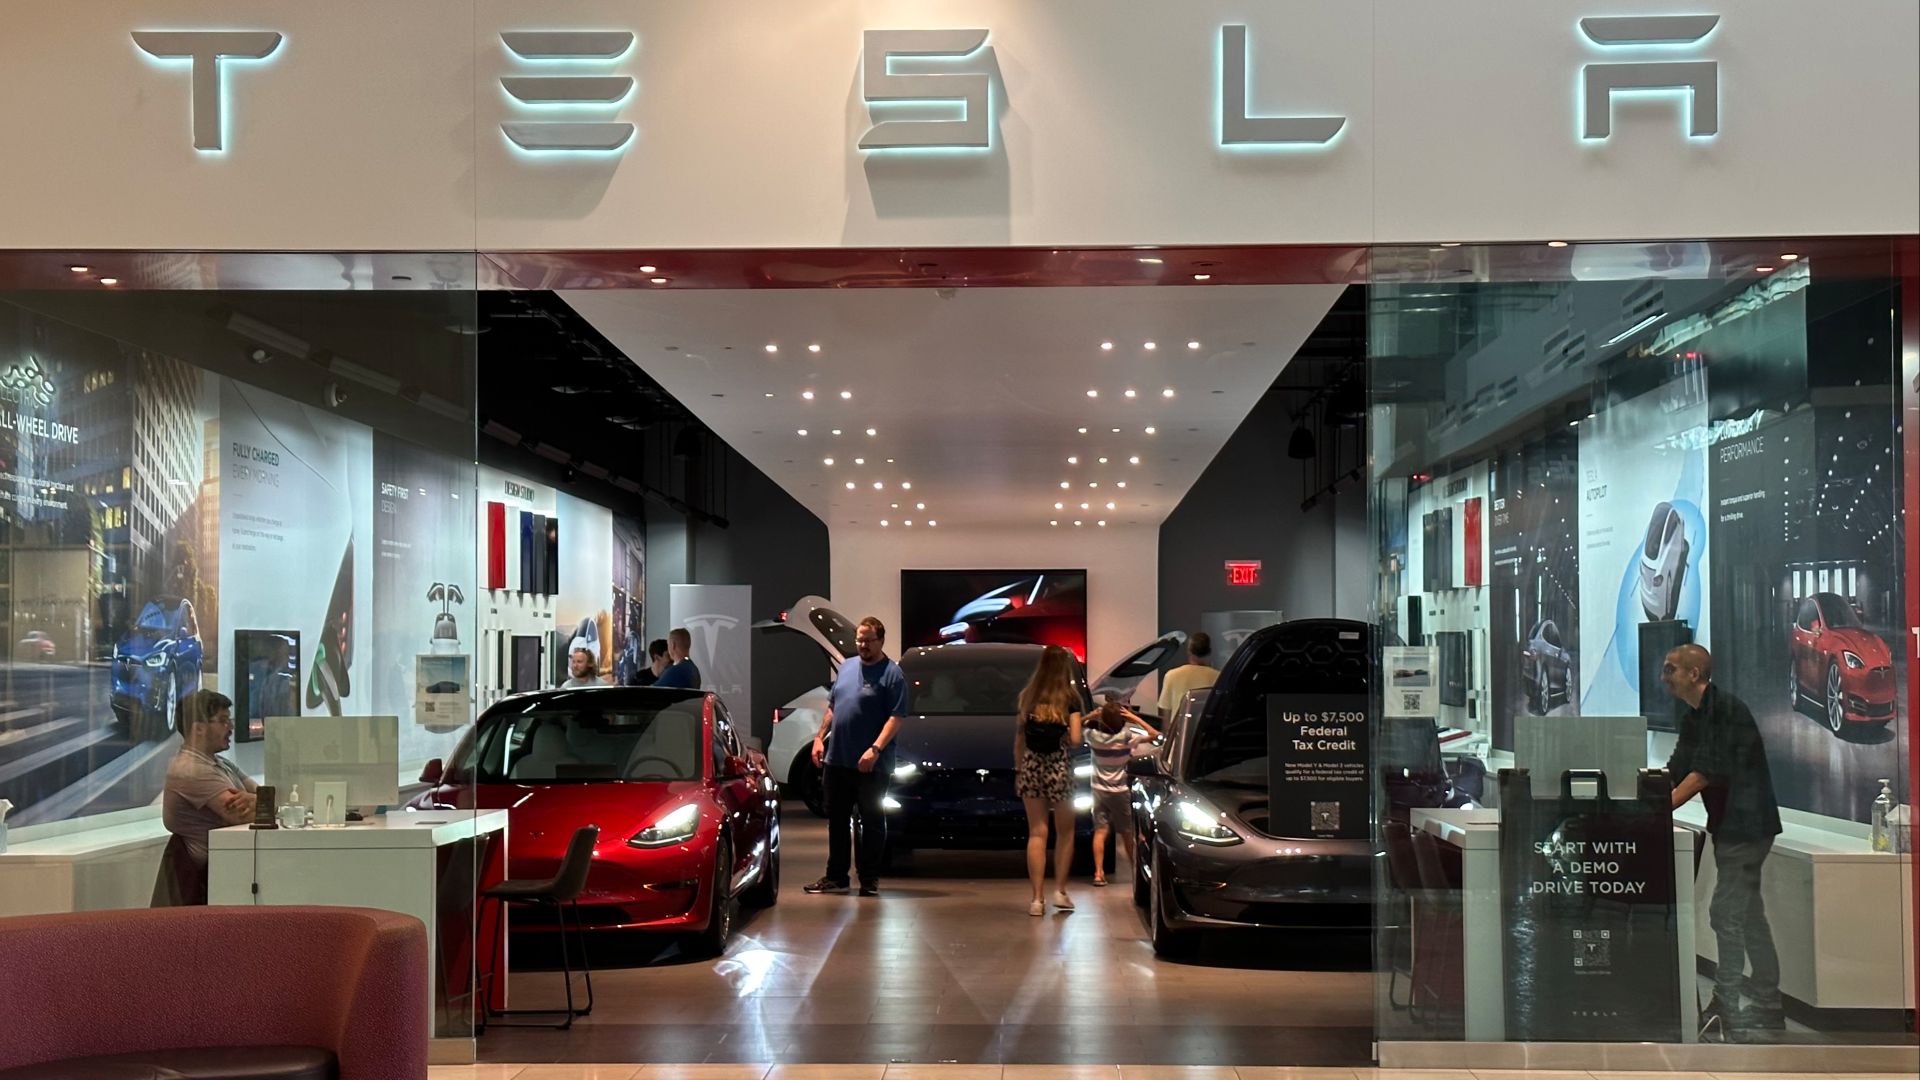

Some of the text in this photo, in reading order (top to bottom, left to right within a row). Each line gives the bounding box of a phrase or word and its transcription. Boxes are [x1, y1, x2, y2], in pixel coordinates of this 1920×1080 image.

[130, 14, 1721, 152] TESLA
[51, 421, 79, 445] DRIVE
[232, 442, 280, 467] FULLY CHARGED
[1720, 436, 1764, 462] PERFORMANCE
[381, 482, 397, 498] SAFETY
[1233, 568, 1255, 583] EXIT
[1283, 712, 1364, 723] Up to $7,500
[1300, 726, 1347, 736] Federal
[1292, 740, 1356, 750] Tax Credit
[1534, 842, 1636, 854] START WITH
[1553, 862, 1619, 873] A DEMO
[1533, 882, 1646, 894] DRIVE TODAY
